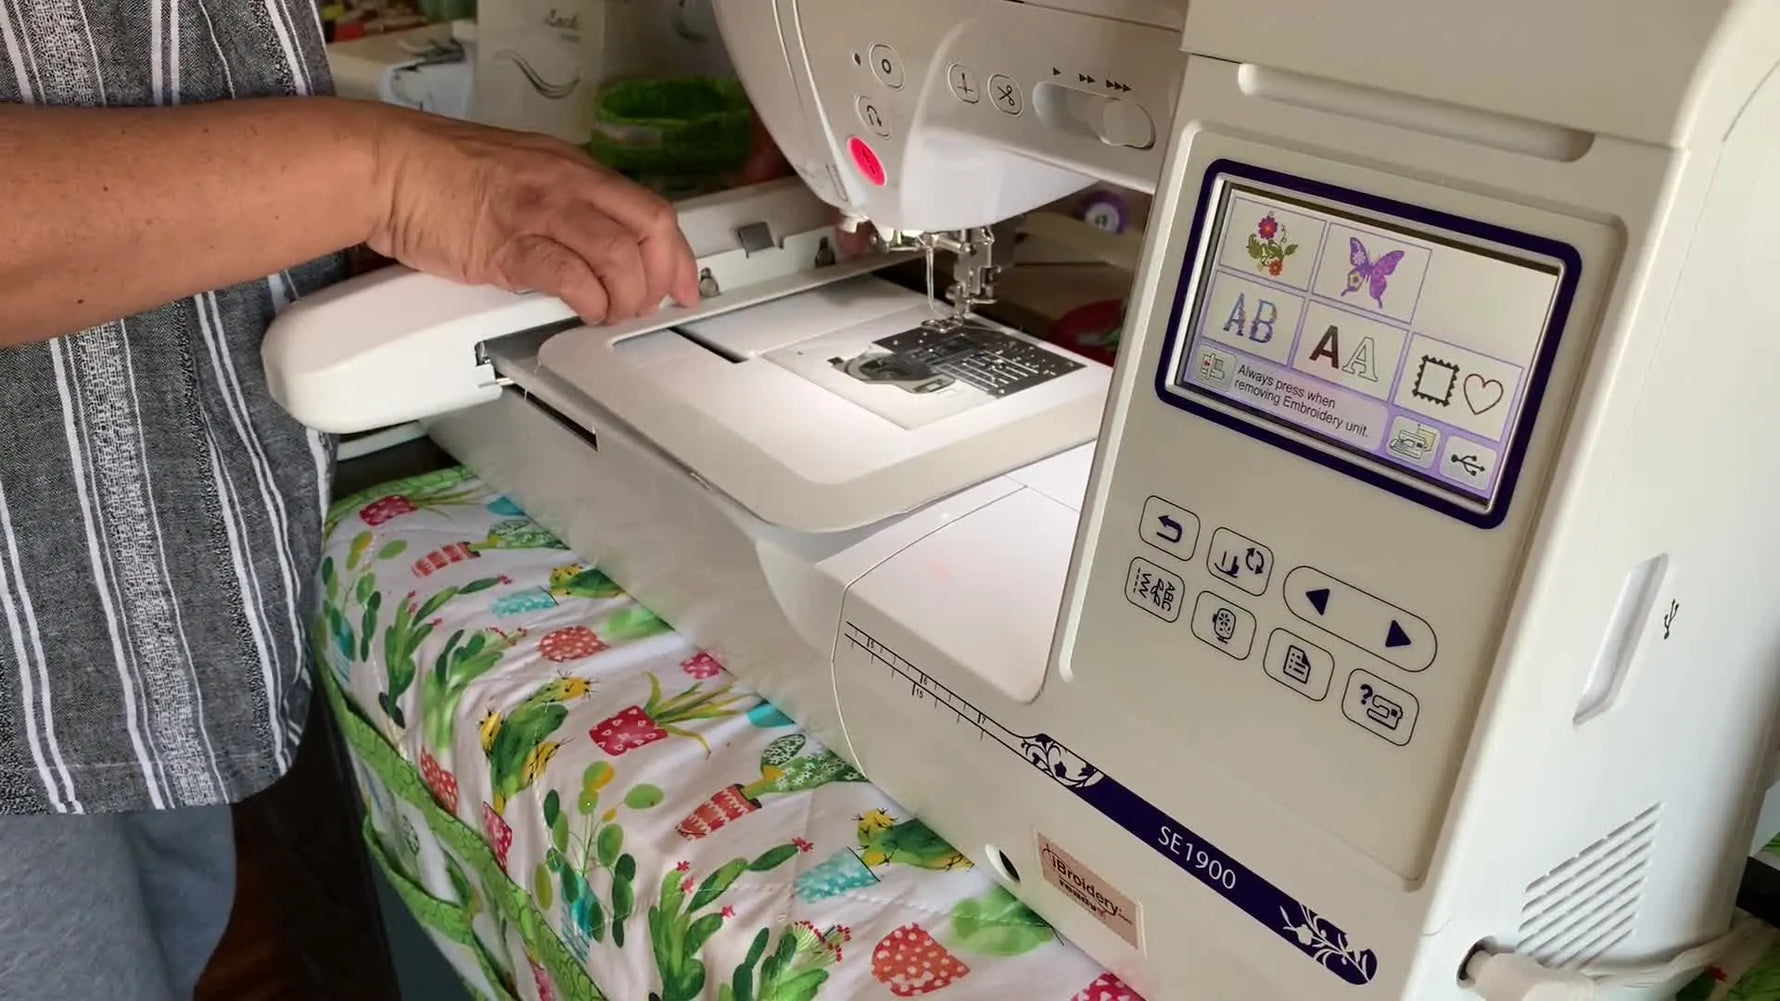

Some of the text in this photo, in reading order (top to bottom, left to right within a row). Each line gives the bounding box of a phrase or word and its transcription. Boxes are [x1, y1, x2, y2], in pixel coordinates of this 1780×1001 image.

[1223, 292, 1278, 344] AB
[1234, 378, 1369, 438] removing Embroidery unit.
[1238, 364, 1336, 409] Always press when
[1161, 580, 1176, 612] ABC
[1158, 825, 1236, 890] SE1900
